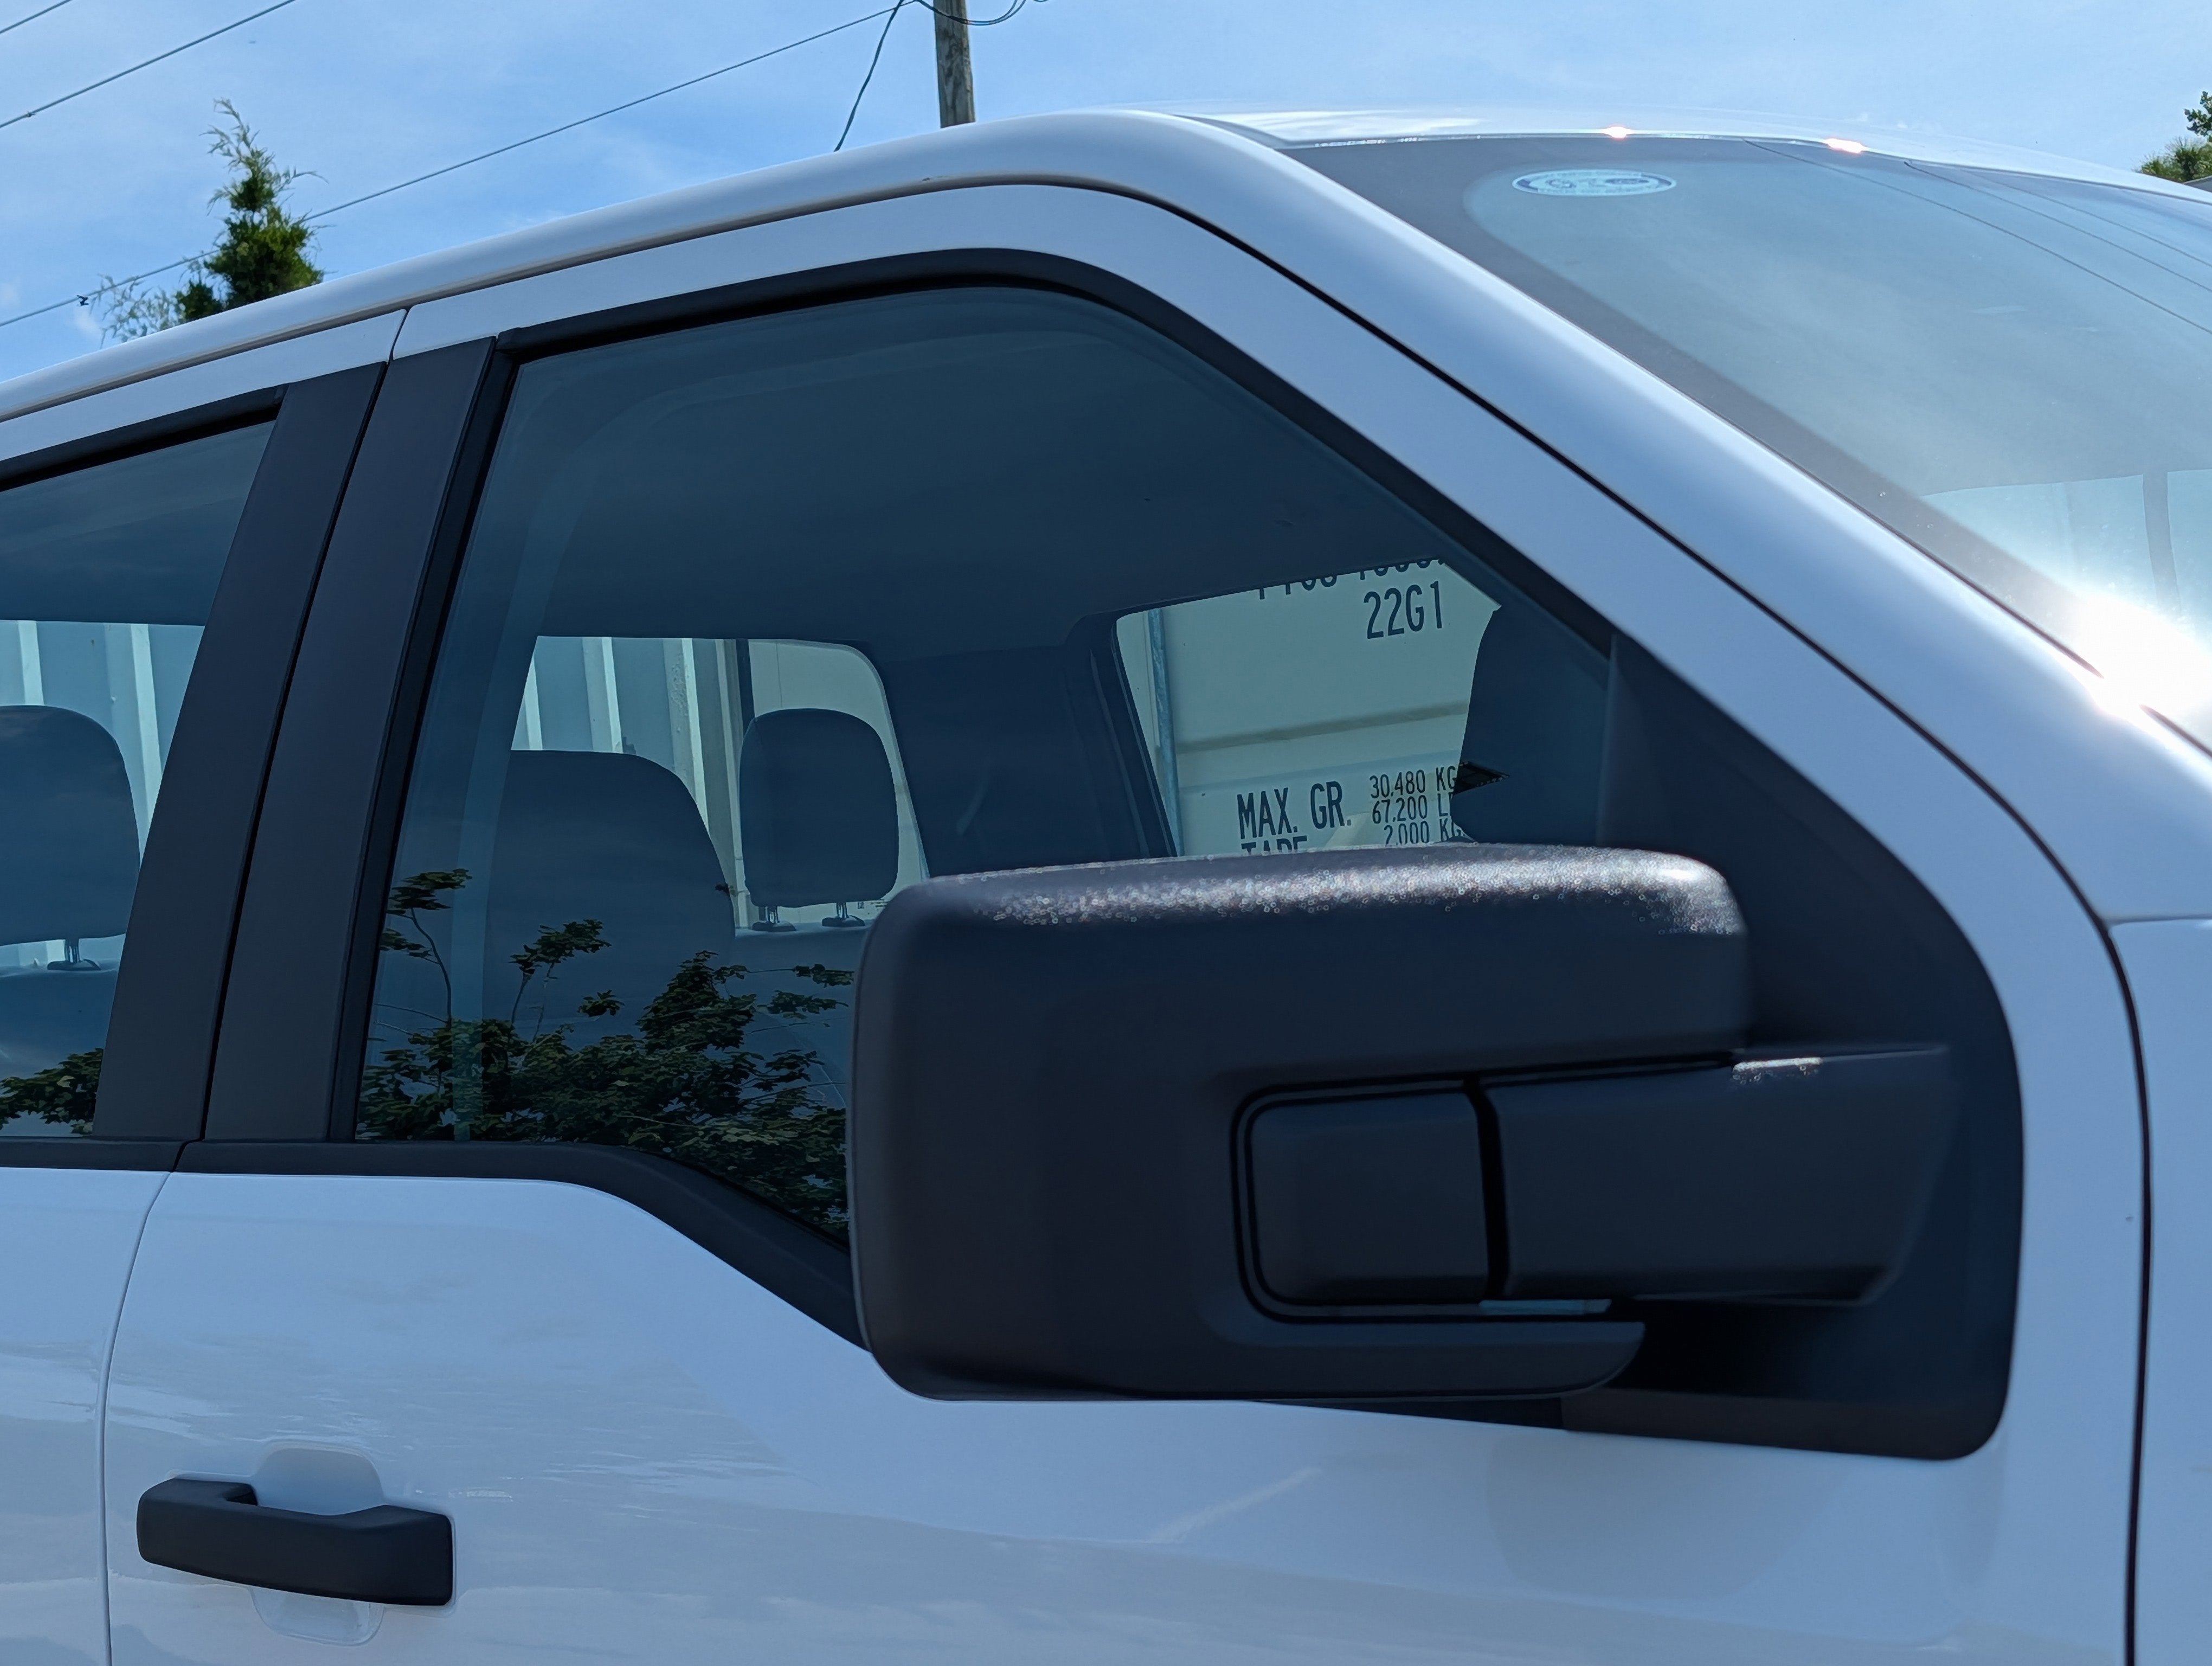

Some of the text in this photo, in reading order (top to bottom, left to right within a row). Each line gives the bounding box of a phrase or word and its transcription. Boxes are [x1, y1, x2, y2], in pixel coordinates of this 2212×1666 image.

[1363, 580, 1442, 639] 22G1
[1237, 780, 1352, 840] MAX. GR.
